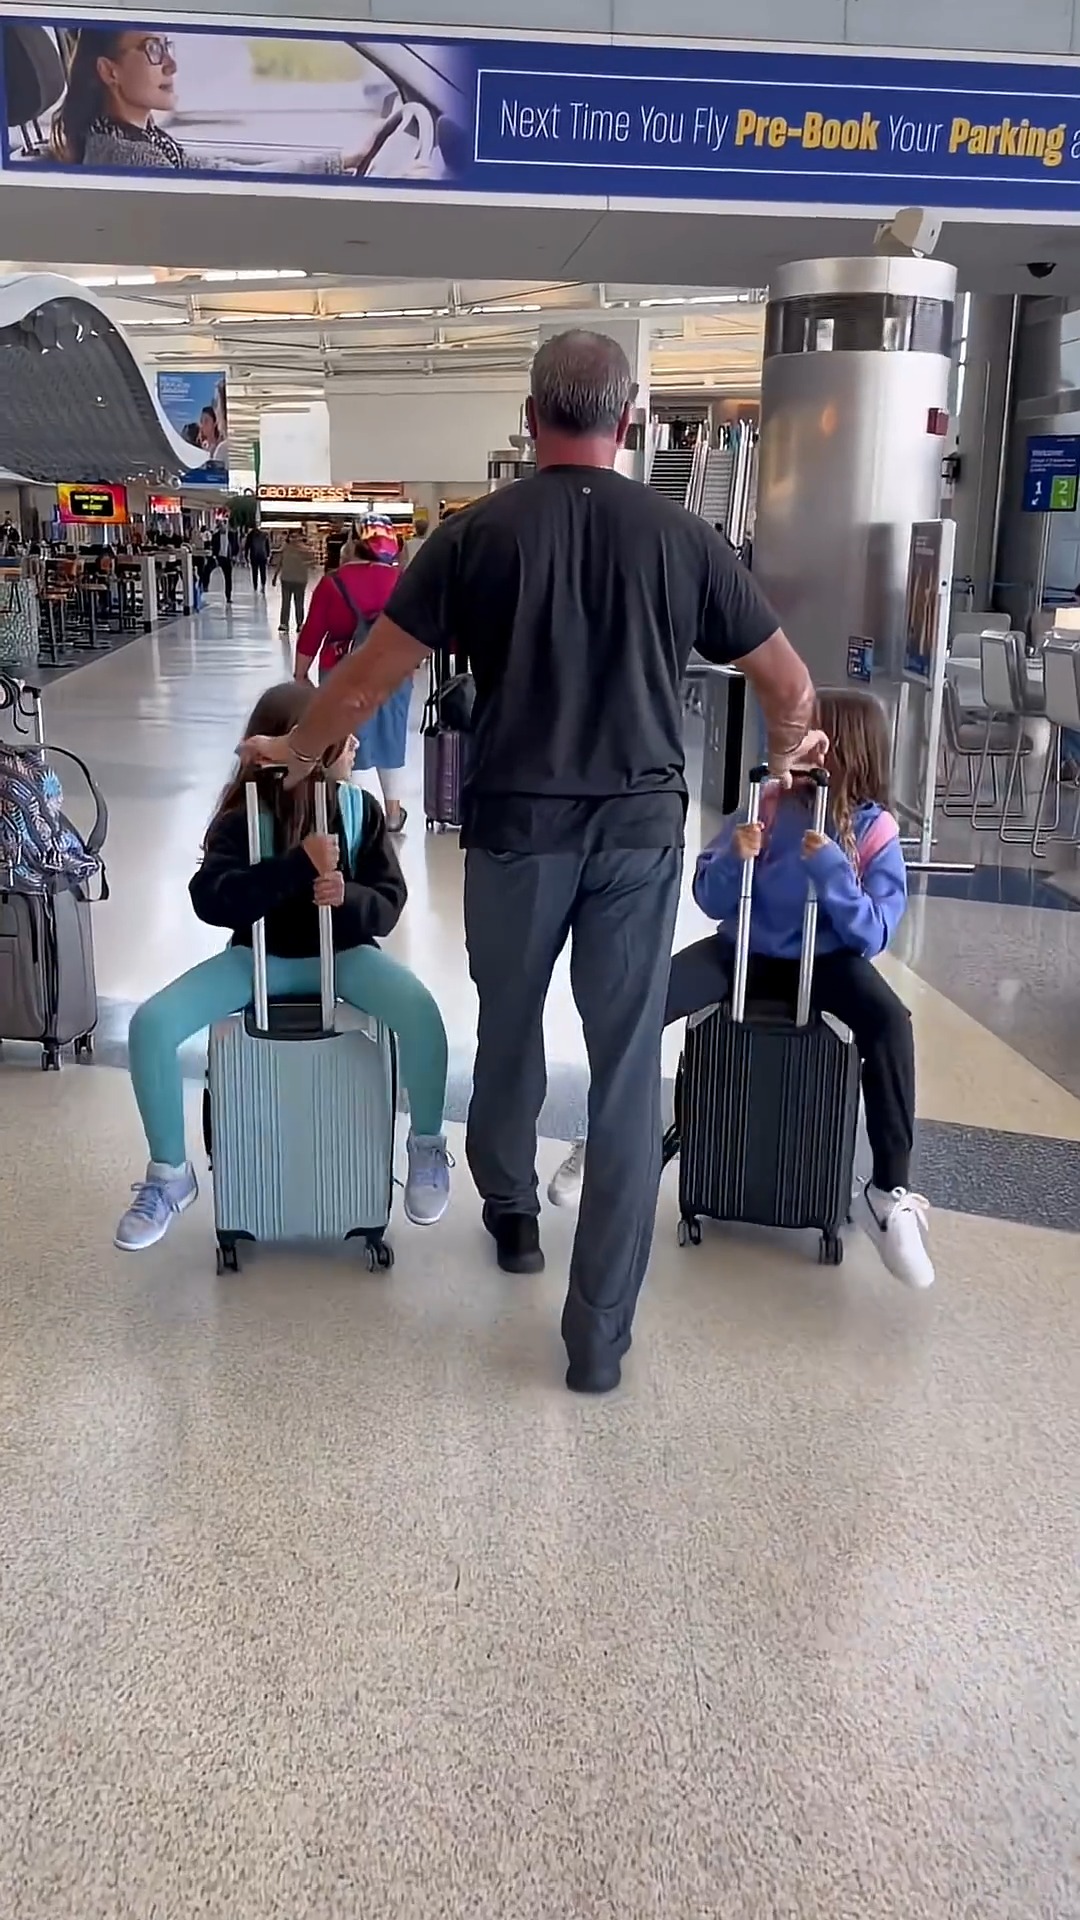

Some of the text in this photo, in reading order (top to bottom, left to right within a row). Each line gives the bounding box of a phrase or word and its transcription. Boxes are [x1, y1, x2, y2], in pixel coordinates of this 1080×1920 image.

[501, 99, 560, 139] Next
[570, 102, 629, 143] Time
[640, 106, 684, 144] You
[694, 108, 728, 152] Fly
[735, 109, 880, 151] Pre-Book
[889, 115, 943, 154] Your
[949, 118, 1067, 167] Parking
[287, 487, 345, 499] EXPRESS
[1035, 480, 1068, 495] 1 2
